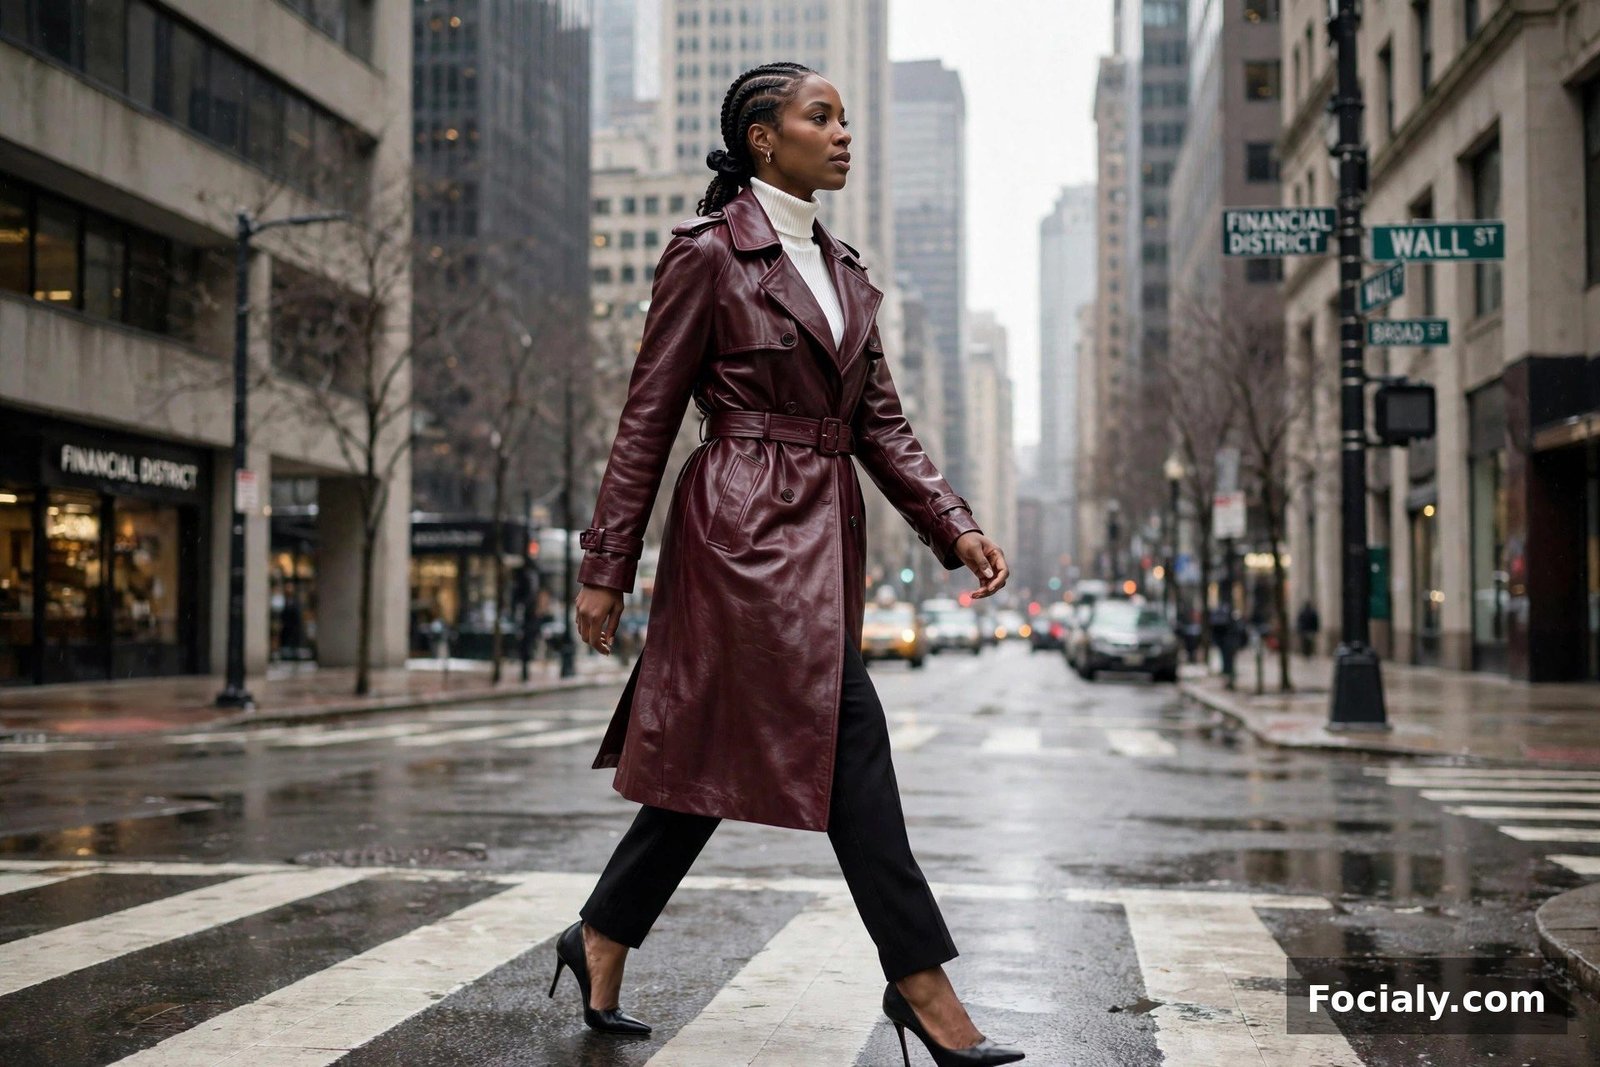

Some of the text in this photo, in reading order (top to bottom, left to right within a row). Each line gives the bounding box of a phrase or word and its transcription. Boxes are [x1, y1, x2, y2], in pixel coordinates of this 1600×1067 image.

[1227, 211, 1332, 232] FINANCIAL
[1229, 231, 1319, 255] DISTRICT
[1389, 226, 1497, 257] WALL ST
[1371, 322, 1424, 344] BROAD
[61, 444, 138, 483] FINANCIAL
[139, 456, 198, 490] DISTRICT
